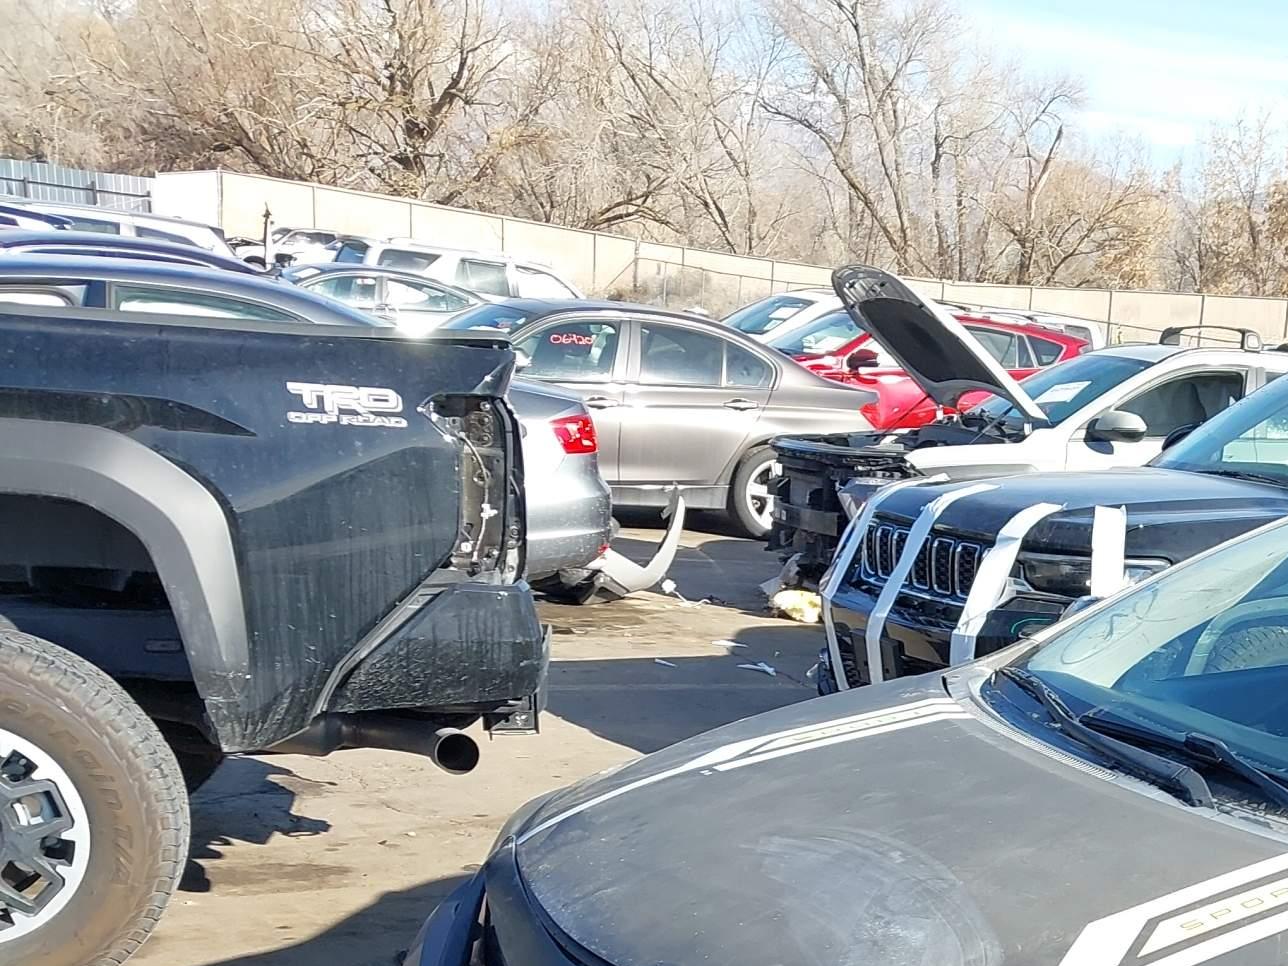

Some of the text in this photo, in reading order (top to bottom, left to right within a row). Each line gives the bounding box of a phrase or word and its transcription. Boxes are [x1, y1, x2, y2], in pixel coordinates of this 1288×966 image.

[286, 381, 403, 416] TRD
[286, 411, 408, 427] OFF ROAD
